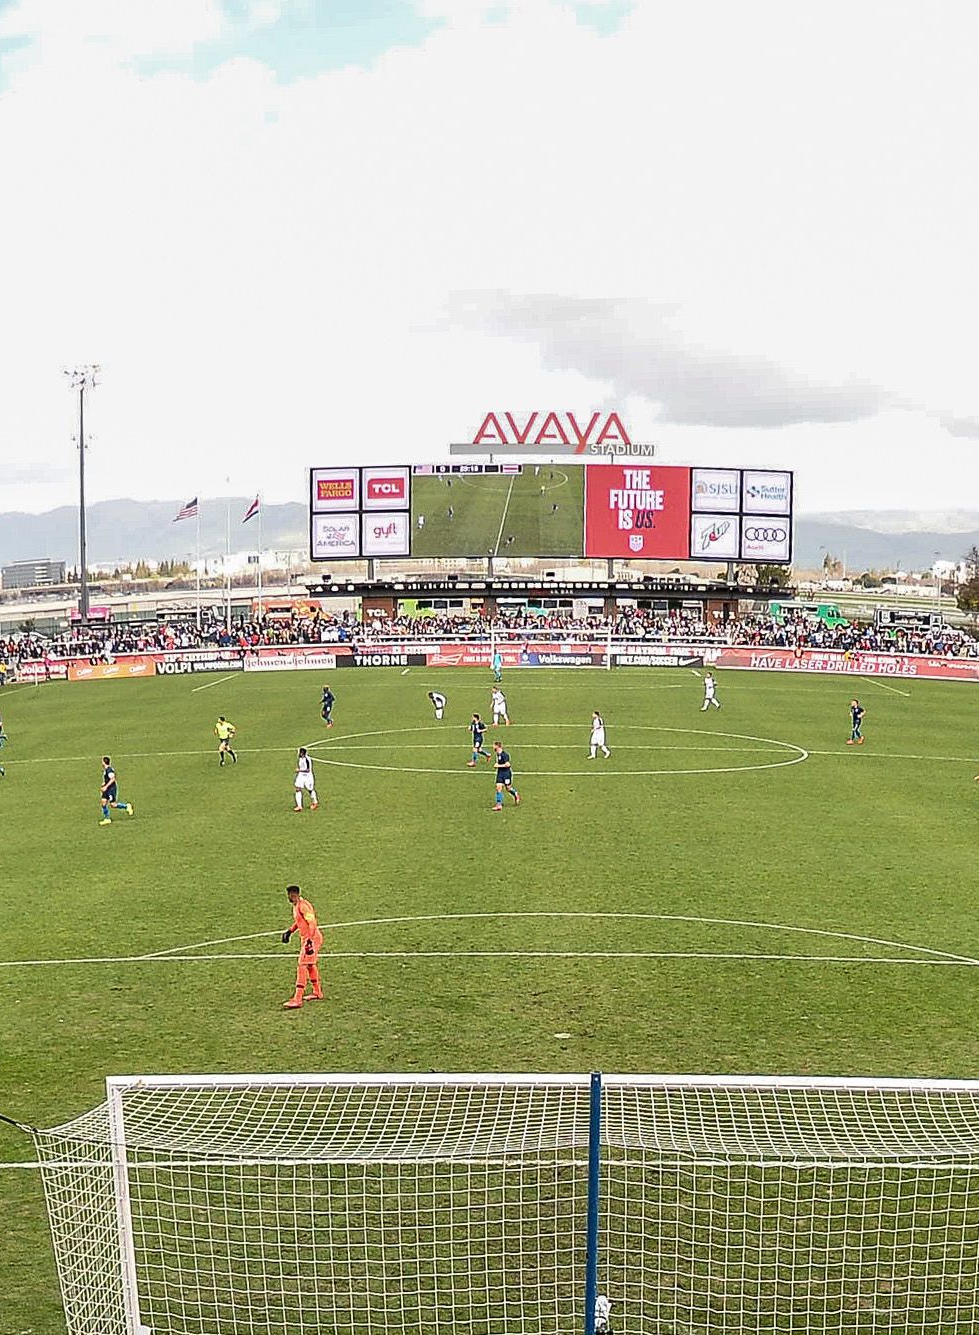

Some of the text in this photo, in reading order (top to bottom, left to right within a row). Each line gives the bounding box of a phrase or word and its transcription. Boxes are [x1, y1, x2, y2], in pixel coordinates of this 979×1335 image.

[472, 411, 631, 454] AVAYA
[589, 444, 655, 456] STADIUM
[623, 469, 651, 490] THE
[319, 482, 352, 490] WELLS
[372, 483, 400, 493] TCL
[320, 489, 352, 497] FARGO
[609, 489, 664, 511] FUTURE
[618, 510, 633, 529] IS
[317, 539, 356, 547] AMERICA
[366, 609, 387, 617] TCL
[353, 654, 408, 666] THORNE
[538, 655, 592, 665] Volkswagen
[751, 657, 782, 668] HAVE
[785, 659, 875, 672] LASER-DRILLED
[878, 662, 917, 675] HOLES
[156, 661, 192, 674] VOLPI
